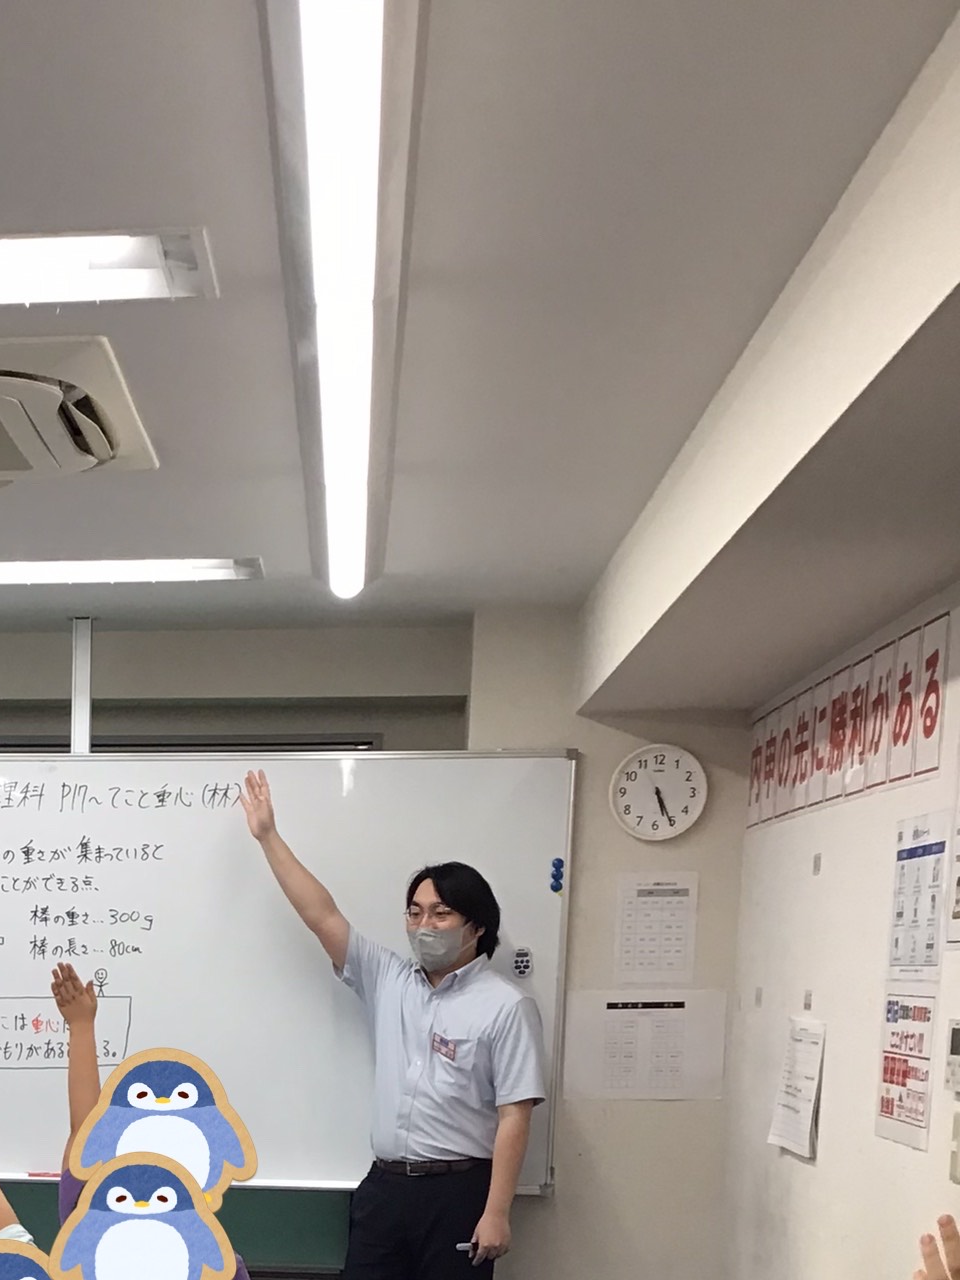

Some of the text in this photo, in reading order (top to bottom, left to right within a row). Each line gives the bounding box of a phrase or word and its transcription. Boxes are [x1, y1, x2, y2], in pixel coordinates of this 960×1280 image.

[638, 760, 648, 769] 11
[653, 754, 666, 765] 12
[674, 759, 680, 769] 1
[625, 771, 638, 782] 10
[685, 771, 693, 782] 2
[619, 787, 627, 798] 9
[689, 787, 697, 798] 3
[623, 804, 631, 815] 8
[681, 805, 689, 815] 4
[636, 816, 644, 826] 7
[651, 820, 659, 831] 6
